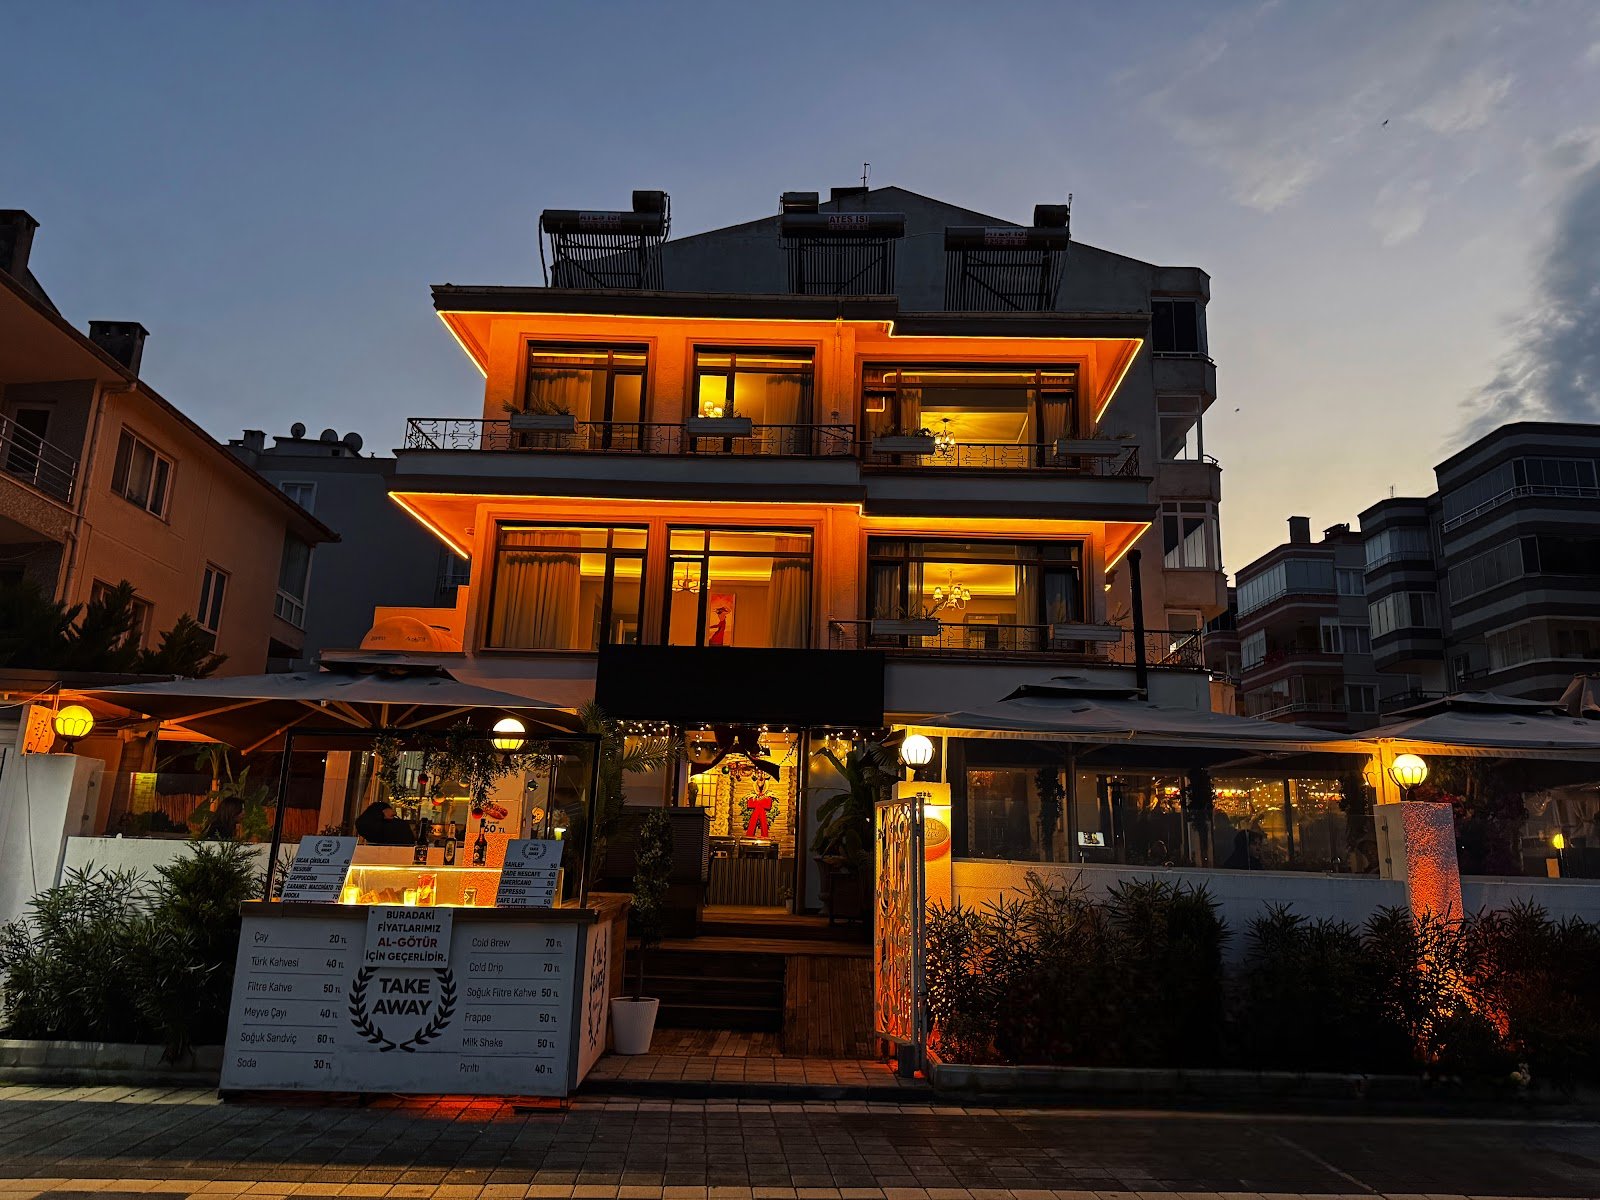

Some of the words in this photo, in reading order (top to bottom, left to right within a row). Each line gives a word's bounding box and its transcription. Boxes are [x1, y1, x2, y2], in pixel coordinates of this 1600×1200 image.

[484, 824, 496, 833] 60
[386, 910, 435, 920] BURADAKİ
[378, 921, 441, 933] FİYATLARIMIZ
[254, 932, 269, 942] Çay
[330, 934, 340, 943] 20
[378, 936, 438, 948] AL-GÖTÜR
[472, 938, 488, 947] Cold
[491, 939, 511, 947] Brew
[545, 938, 555, 948] 70
[366, 950, 385, 962] İÇİN
[388, 951, 447, 962] GEÇERLİDİR.
[251, 957, 267, 966] Türk
[269, 957, 299, 968] Kahvesi
[326, 960, 336, 968] 40
[469, 962, 486, 972] Cold
[488, 963, 503, 974] Drip
[543, 963, 552, 972] 70
[248, 982, 267, 992] Filtre
[268, 982, 292, 992] Kahve
[323, 984, 333, 993] 50
[379, 978, 430, 994] TAKE
[467, 988, 490, 999] Soğuk
[493, 988, 511, 997] Filtre
[514, 988, 537, 997] Kahve
[541, 989, 551, 998] 50
[372, 999, 432, 1015] AWAY
[244, 1008, 268, 1018] Meyve
[271, 1008, 287, 1019] Çayı
[320, 1009, 330, 1018] 40
[464, 1013, 492, 1024] Frappe
[539, 1014, 550, 1022] 50
[240, 1032, 264, 1043] Soğuk
[266, 1033, 297, 1044] Sandviç
[317, 1035, 327, 1044] 60
[462, 1038, 478, 1047] Milk
[479, 1038, 503, 1047] Shake
[537, 1039, 548, 1048] 50
[237, 1058, 257, 1068] Soda
[314, 1060, 324, 1069] 30
[535, 1065, 545, 1073] 40
